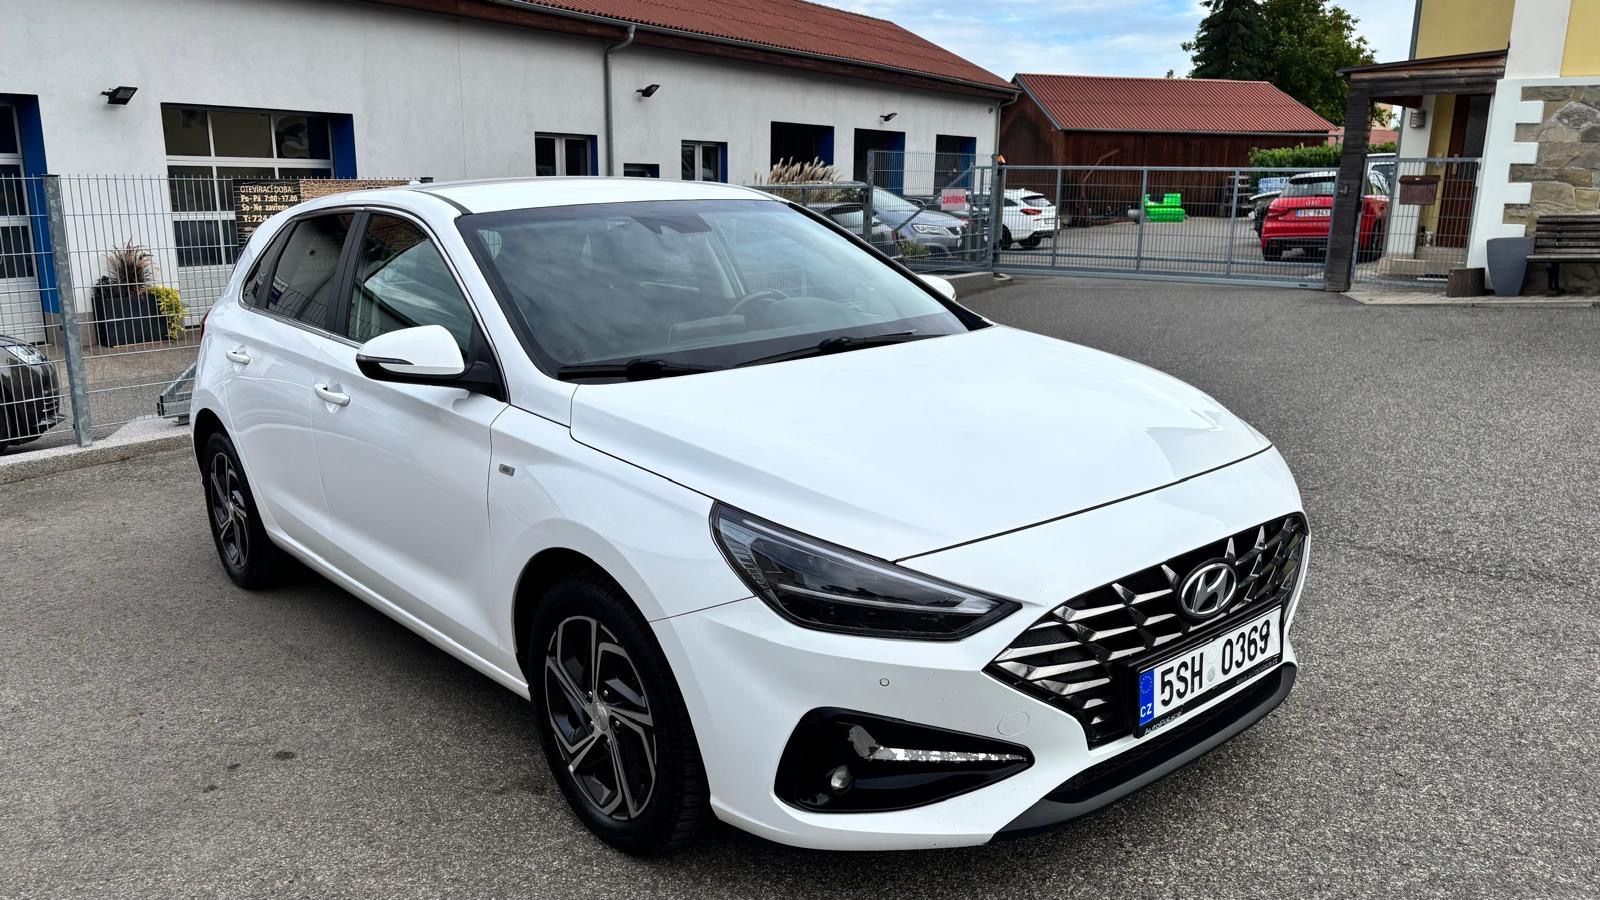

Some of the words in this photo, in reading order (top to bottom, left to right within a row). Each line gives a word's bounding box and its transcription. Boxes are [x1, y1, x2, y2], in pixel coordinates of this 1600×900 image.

[1160, 652, 1204, 706] 5SH
[1221, 619, 1270, 675] 0369
[1140, 702, 1153, 718] CZ
